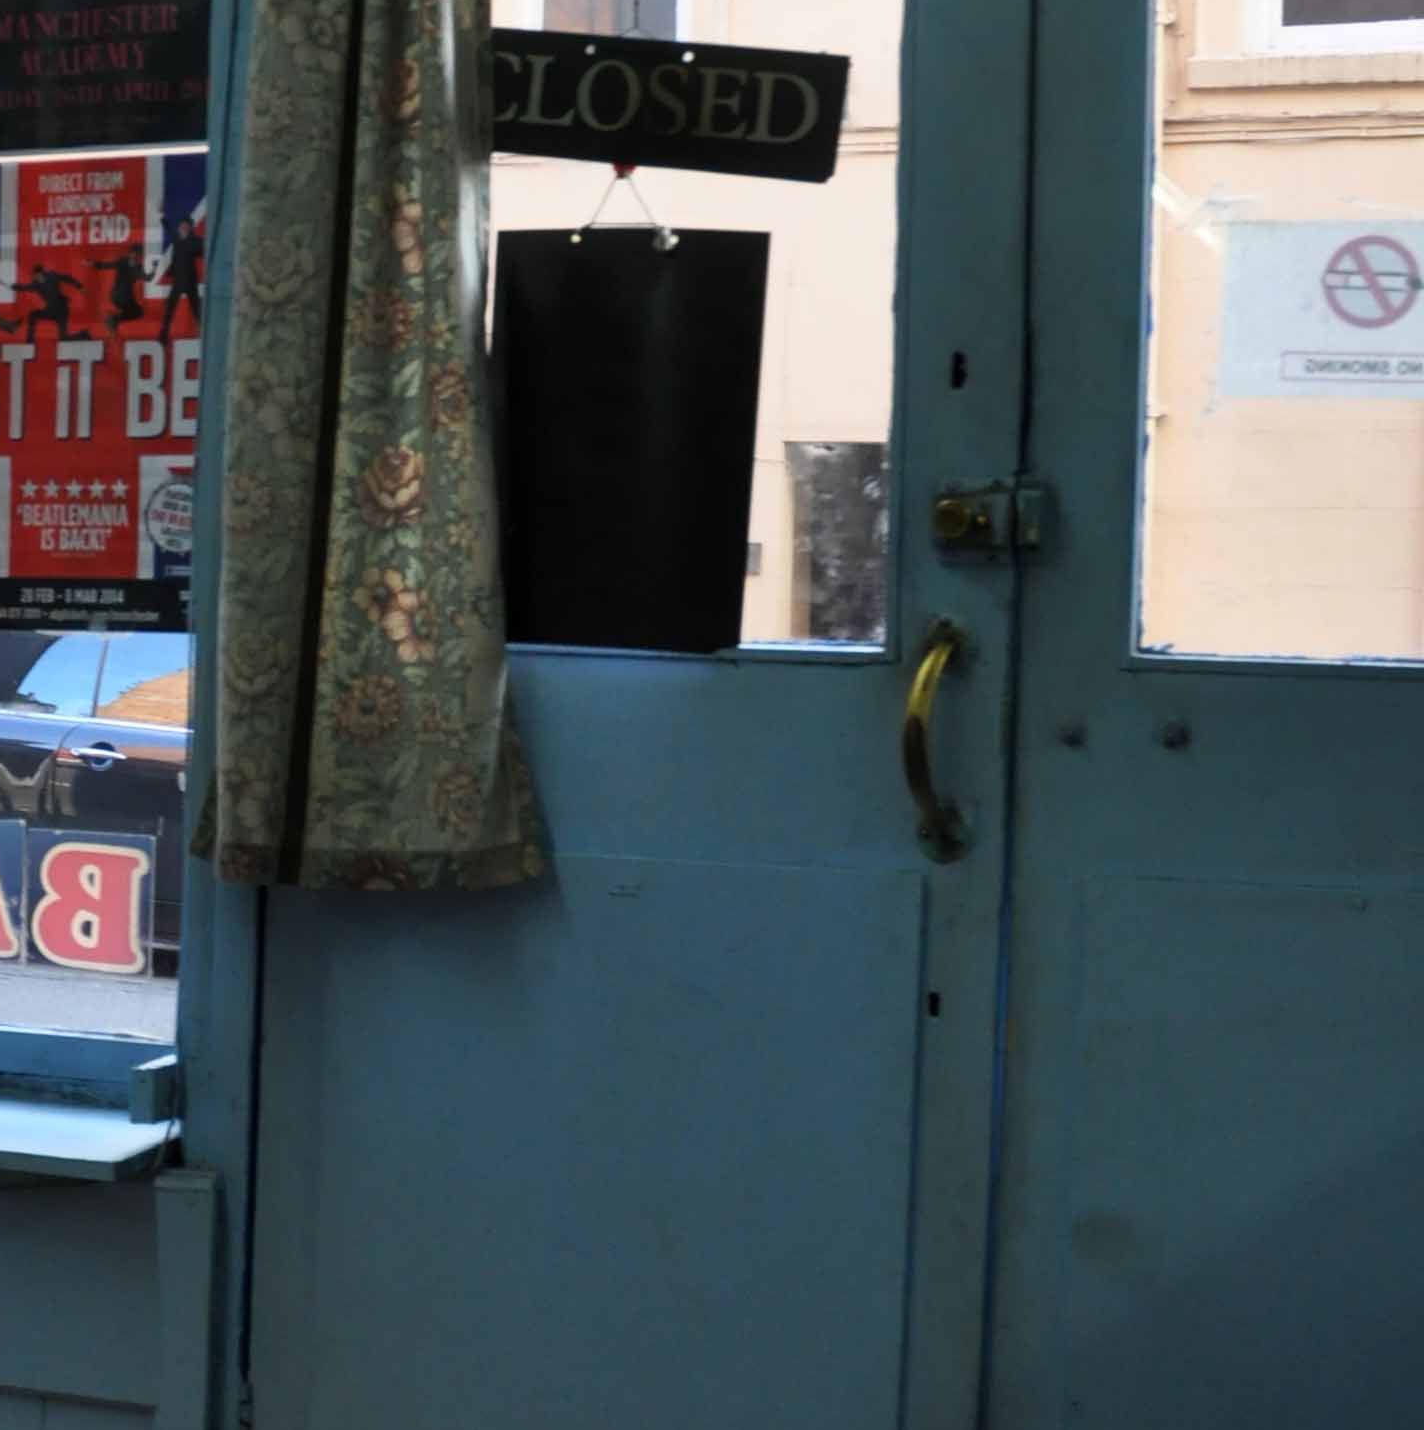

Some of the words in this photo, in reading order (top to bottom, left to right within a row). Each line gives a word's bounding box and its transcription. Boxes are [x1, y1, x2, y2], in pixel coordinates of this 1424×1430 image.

[39, 173, 83, 193] DIRECT
[86, 170, 124, 191] FROM
[30, 215, 82, 247] WEST
[88, 212, 131, 245] END
[55, 340, 105, 440] IT
[40, 528, 55, 551] IS
